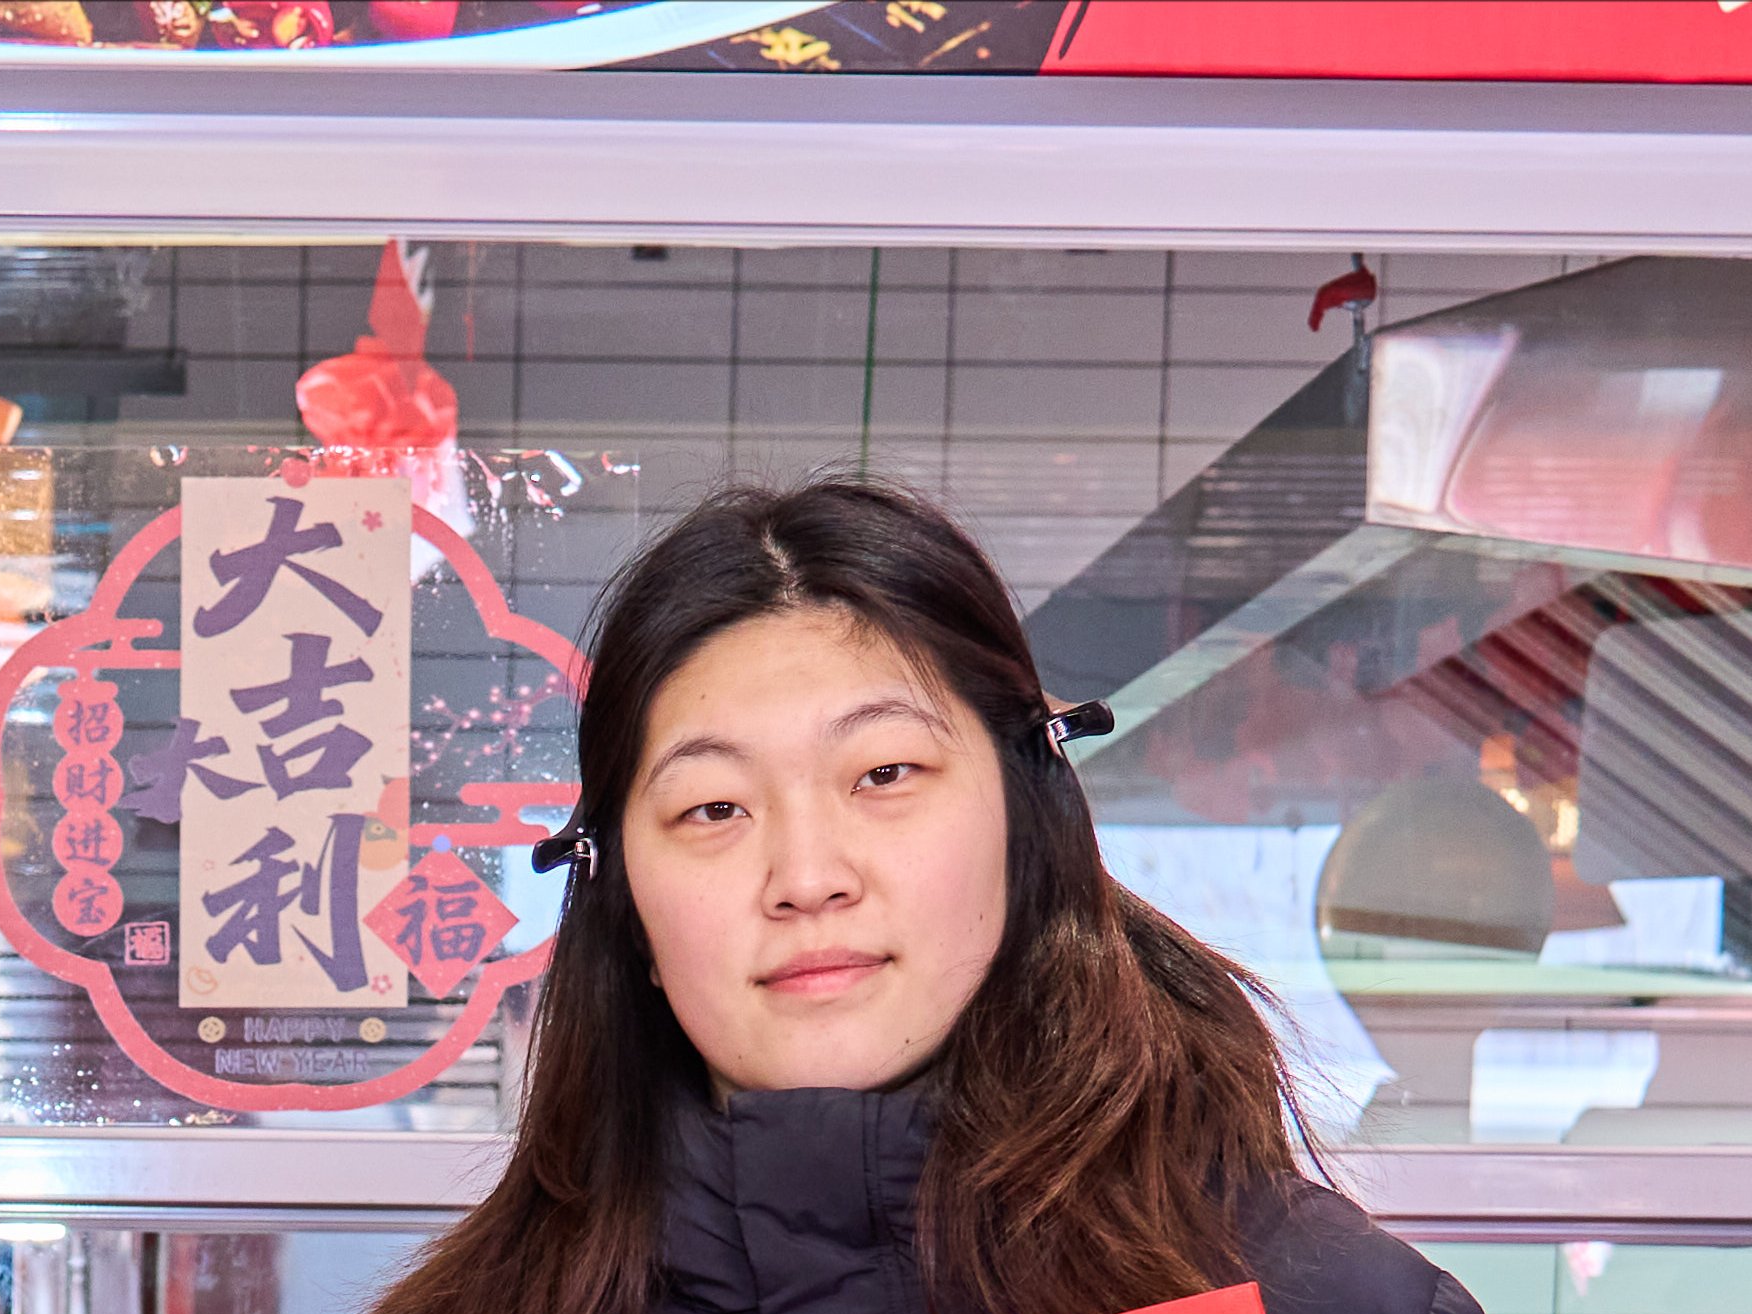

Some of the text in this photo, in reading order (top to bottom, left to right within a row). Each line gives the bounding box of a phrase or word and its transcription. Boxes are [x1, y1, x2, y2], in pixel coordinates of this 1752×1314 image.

[64, 698, 115, 928] 招财进宝
[395, 874, 488, 968] 福
[242, 1016, 347, 1045] HAPPY
[214, 1048, 369, 1076] NEW YEAR
